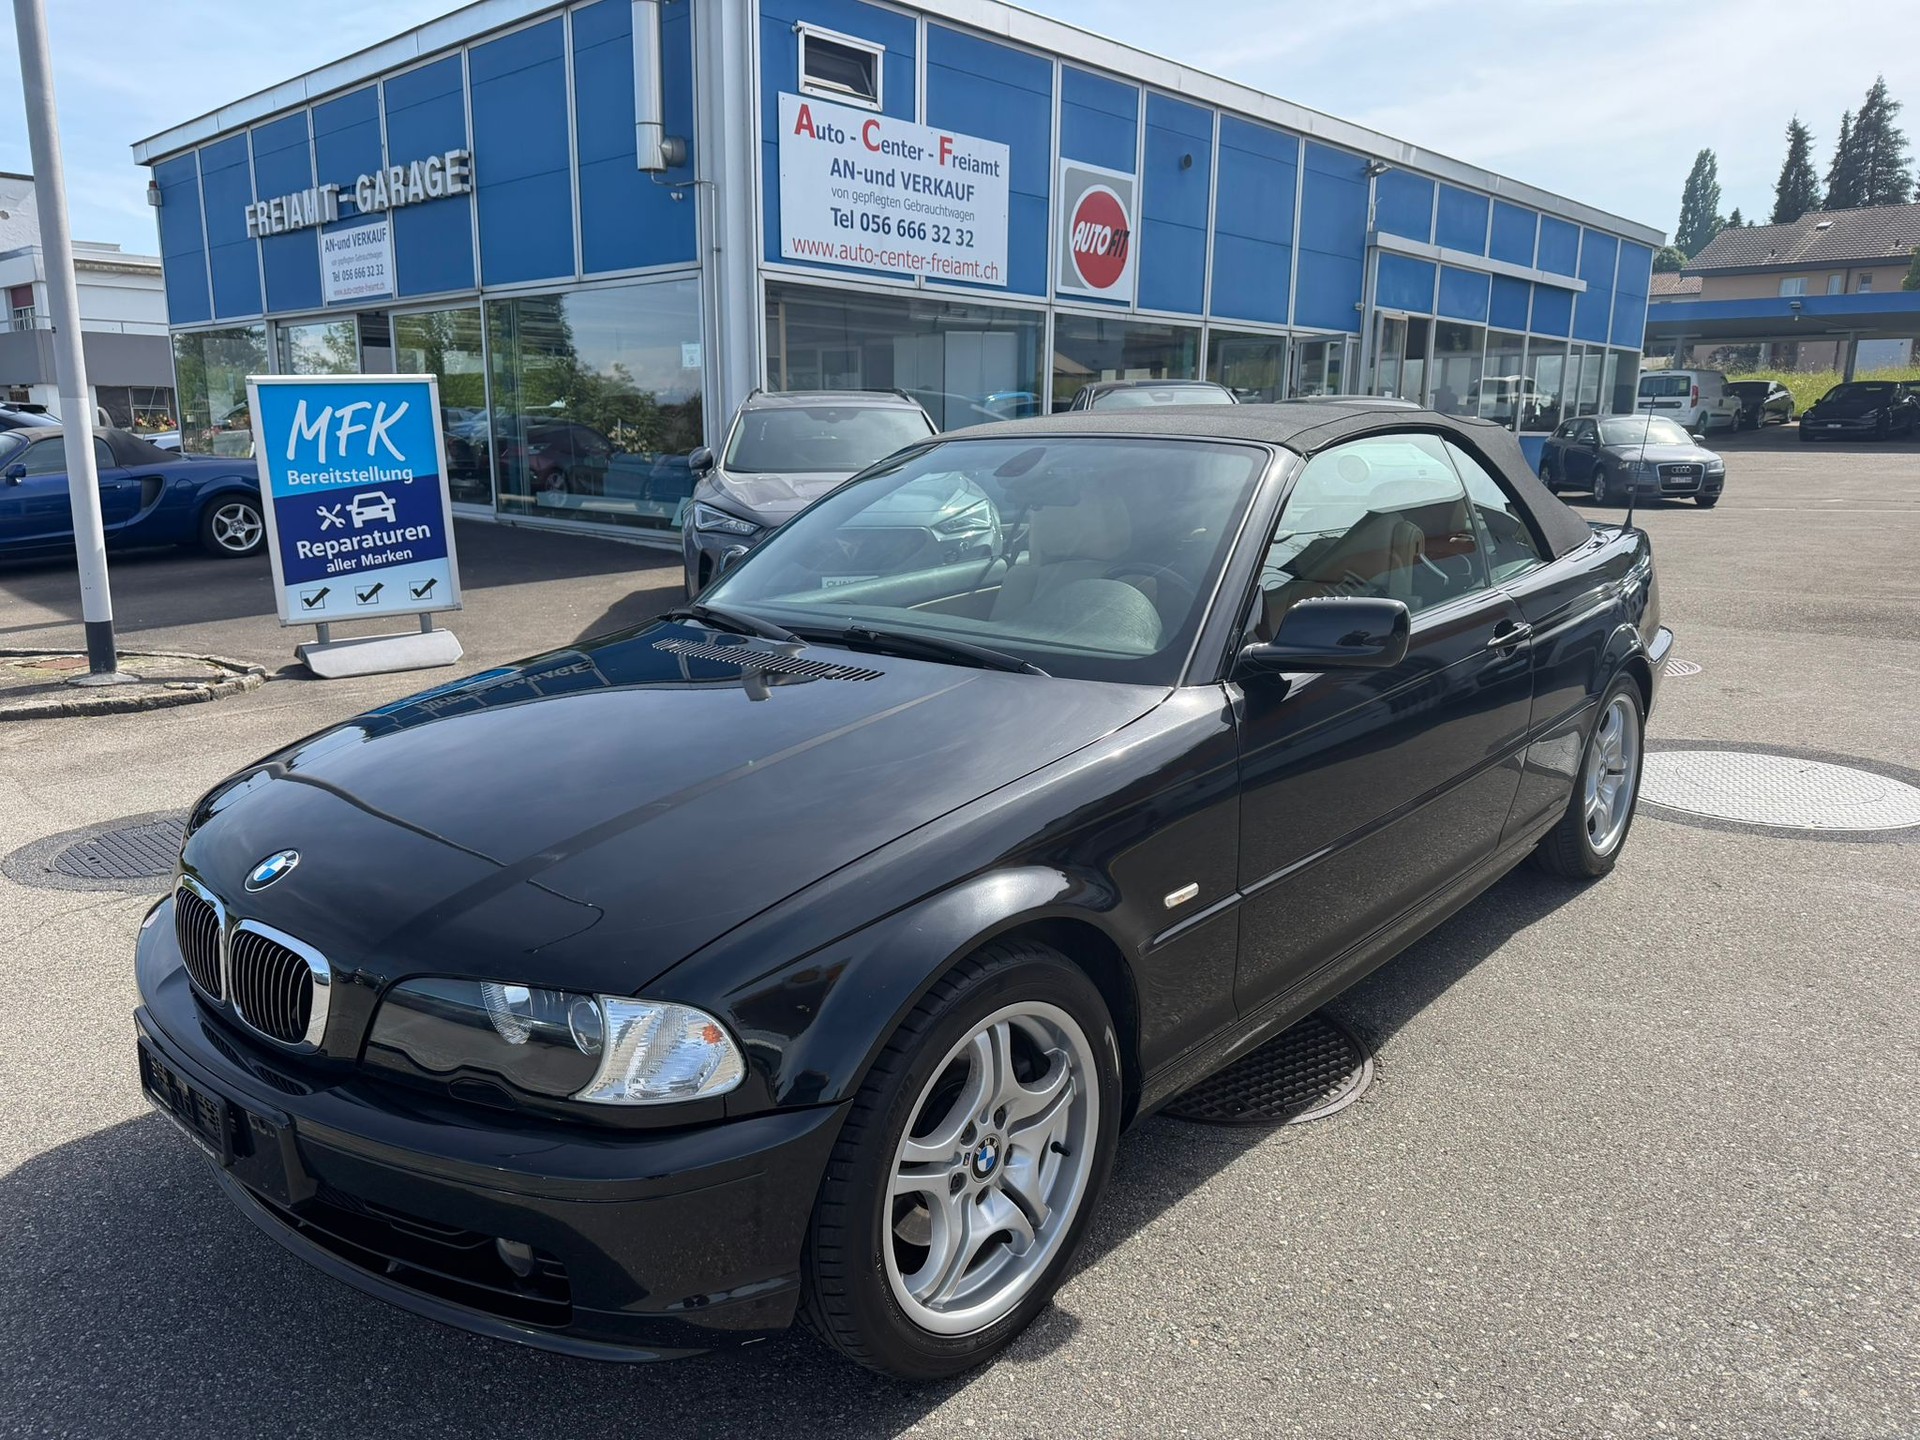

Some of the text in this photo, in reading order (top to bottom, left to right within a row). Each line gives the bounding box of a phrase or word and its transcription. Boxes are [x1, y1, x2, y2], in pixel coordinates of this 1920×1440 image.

[794, 103, 845, 145] Auto
[862, 118, 924, 161] Center
[939, 135, 1000, 177] Freiamt
[830, 157, 975, 203] AN-und VERKAUF
[831, 187, 975, 223] von gepflegten Gebrauchtwagen
[352, 228, 386, 247] VERKAUF
[830, 207, 975, 248] Tel 056 666 32 32
[332, 264, 384, 282] Tel 056 666 32 32
[792, 237, 999, 281] www.auto-center-freiamt.ch
[286, 399, 410, 464] MFK
[287, 467, 413, 484] Bereitstellung
[296, 523, 431, 560] Reparaturen
[326, 548, 413, 574] aller Marken
